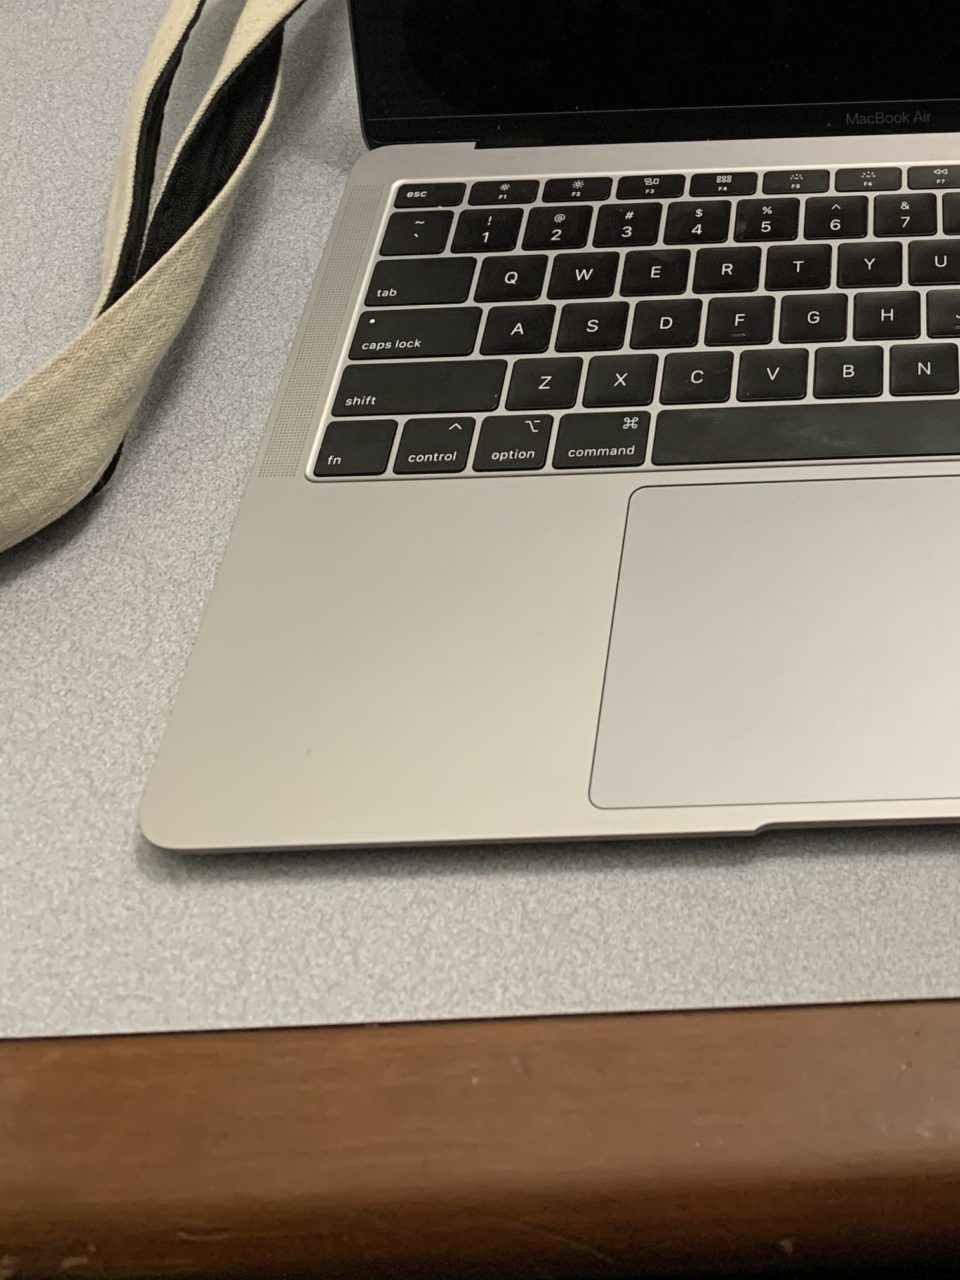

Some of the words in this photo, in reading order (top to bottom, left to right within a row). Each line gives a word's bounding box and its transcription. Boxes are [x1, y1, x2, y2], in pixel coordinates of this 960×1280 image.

[845, 110, 911, 126] MacBook
[912, 109, 933, 124] Air
[406, 190, 428, 198] esc
[761, 205, 773, 215] %
[900, 201, 910, 210] &
[553, 213, 566, 223] @
[624, 210, 635, 220] #
[695, 208, 704, 218] $
[760, 220, 772, 233] 5
[829, 218, 841, 231] 6
[900, 216, 911, 228] 7
[550, 228, 562, 241] 2
[621, 225, 633, 238] 3
[690, 223, 703, 235] 4
[483, 232, 489, 242] 1
[792, 260, 805, 273] T
[863, 257, 876, 271] Y
[934, 255, 948, 268] U
[575, 268, 594, 281] W
[650, 265, 662, 279] E
[721, 263, 734, 276] R
[504, 271, 519, 285] Q
[376, 288, 398, 298] tab
[734, 313, 746, 327] F
[807, 310, 821, 324] G
[880, 308, 894, 322] H
[510, 322, 524, 336] A
[586, 319, 599, 333] S
[659, 316, 673, 330] D
[361, 341, 392, 351] caps
[394, 338, 422, 349] lock
[766, 366, 780, 381] V
[842, 364, 855, 378] B
[917, 361, 931, 376] N
[538, 375, 553, 390] Z
[613, 372, 628, 387] X
[690, 369, 704, 384] C
[345, 395, 377, 406] shift
[407, 450, 457, 463] control
[491, 448, 536, 462] option
[567, 444, 636, 458] command
[327, 455, 342, 465] fn
